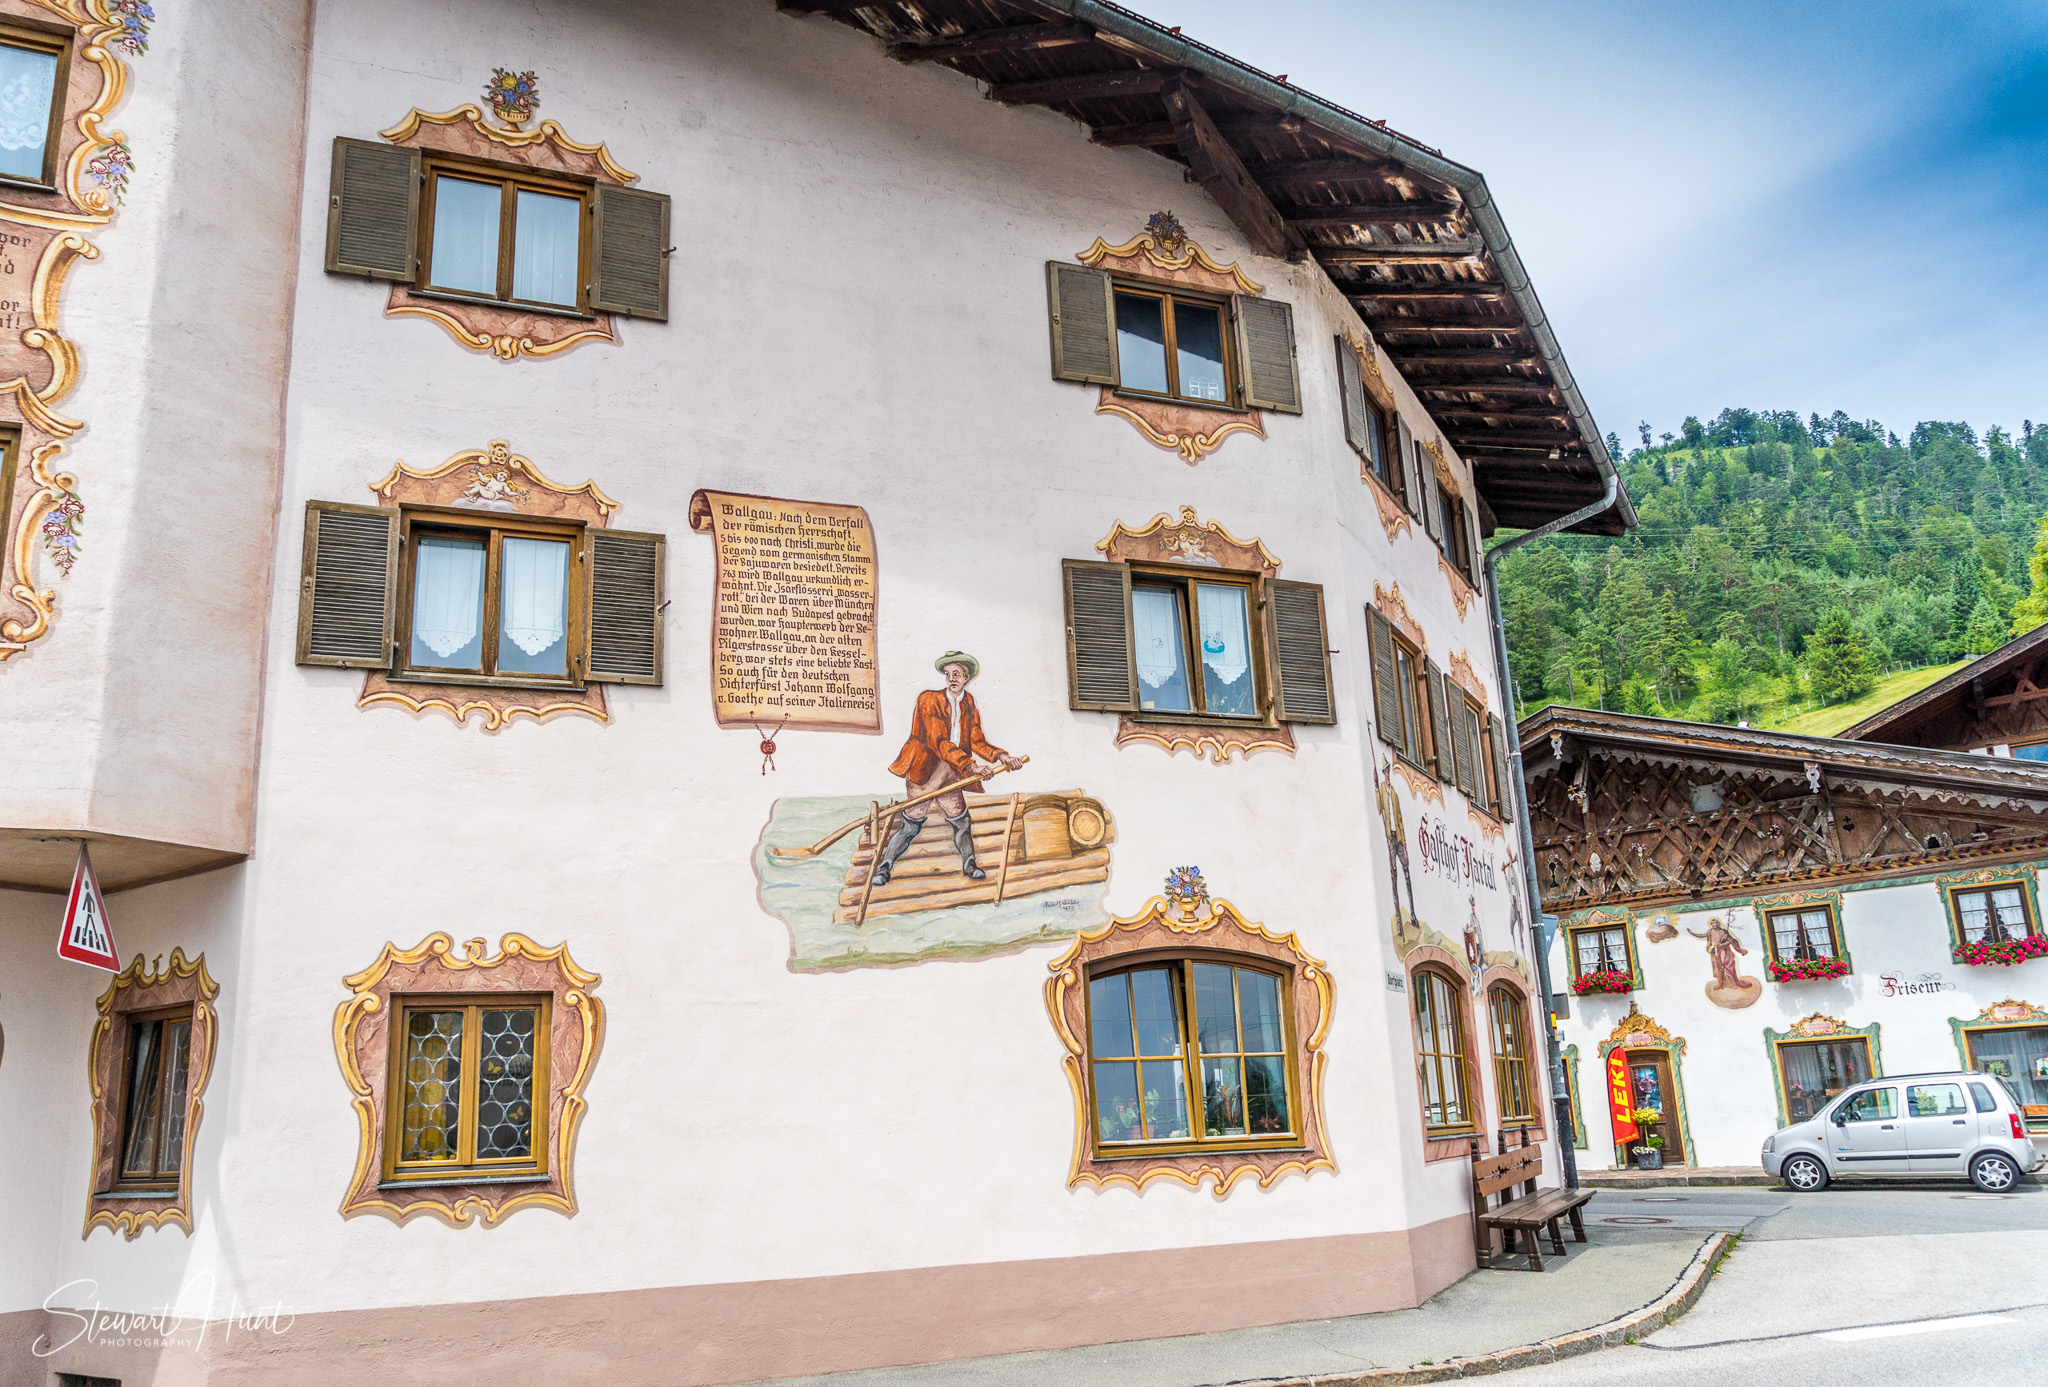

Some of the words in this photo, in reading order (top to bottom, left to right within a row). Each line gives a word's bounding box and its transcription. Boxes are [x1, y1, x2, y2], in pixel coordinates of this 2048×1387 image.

[721, 504, 776, 521] Wallgau:
[779, 512, 802, 524] Nach
[805, 512, 827, 526] dem
[722, 519, 742, 530] der
[744, 521, 796, 535] römischen
[728, 533, 742, 544] bis
[760, 536, 782, 548] nach
[847, 541, 861, 552] die
[722, 544, 756, 558] Gegend
[760, 549, 780, 558] vom
[782, 550, 840, 562] germanischen
[842, 553, 872, 564] Stamm
[724, 556, 739, 566] der
[740, 556, 791, 570] Bajuwaren
[722, 569, 736, 578] 763
[738, 568, 760, 580] wird
[762, 570, 803, 584] Wallgau
[806, 574, 852, 587] urkundlich
[757, 581, 772, 592] Die
[746, 592, 758, 603] bei
[760, 592, 776, 604] der
[779, 594, 810, 606] Waren
[813, 596, 834, 608] über
[834, 598, 874, 610] München
[721, 604, 739, 614] und
[742, 604, 763, 614] Wien
[766, 606, 788, 618] nach
[792, 607, 834, 620] Budapest
[836, 610, 874, 623] gebracht
[778, 618, 836, 632] Haupterwerb
[839, 622, 854, 632] der
[856, 622, 872, 633] Be-
[718, 638, 784, 652] Pilgerstrasse
[786, 642, 808, 654] über
[810, 644, 828, 656] den
[830, 646, 867, 658] Kessel-
[805, 634, 817, 643] an
[820, 633, 835, 644] der
[838, 634, 862, 646] alten
[720, 652, 743, 666] berg
[745, 656, 766, 664] war
[768, 654, 792, 666] stets
[796, 656, 814, 667] eine
[818, 658, 852, 668] beliebte
[720, 664, 734, 676] So
[736, 666, 760, 679] auch
[762, 666, 778, 680] für
[781, 666, 798, 679] den
[802, 668, 850, 682] deutschen
[720, 677, 781, 692] Dichterfürst
[784, 680, 824, 694] Johann
[826, 682, 874, 698] Wolfgang
[728, 691, 764, 706] Goethe
[767, 694, 784, 707] auf
[786, 694, 816, 707] seiner
[818, 696, 875, 710] Italienreise
[1879, 971, 1952, 997] Friseur
[1610, 1058, 1632, 1124] LEKI
